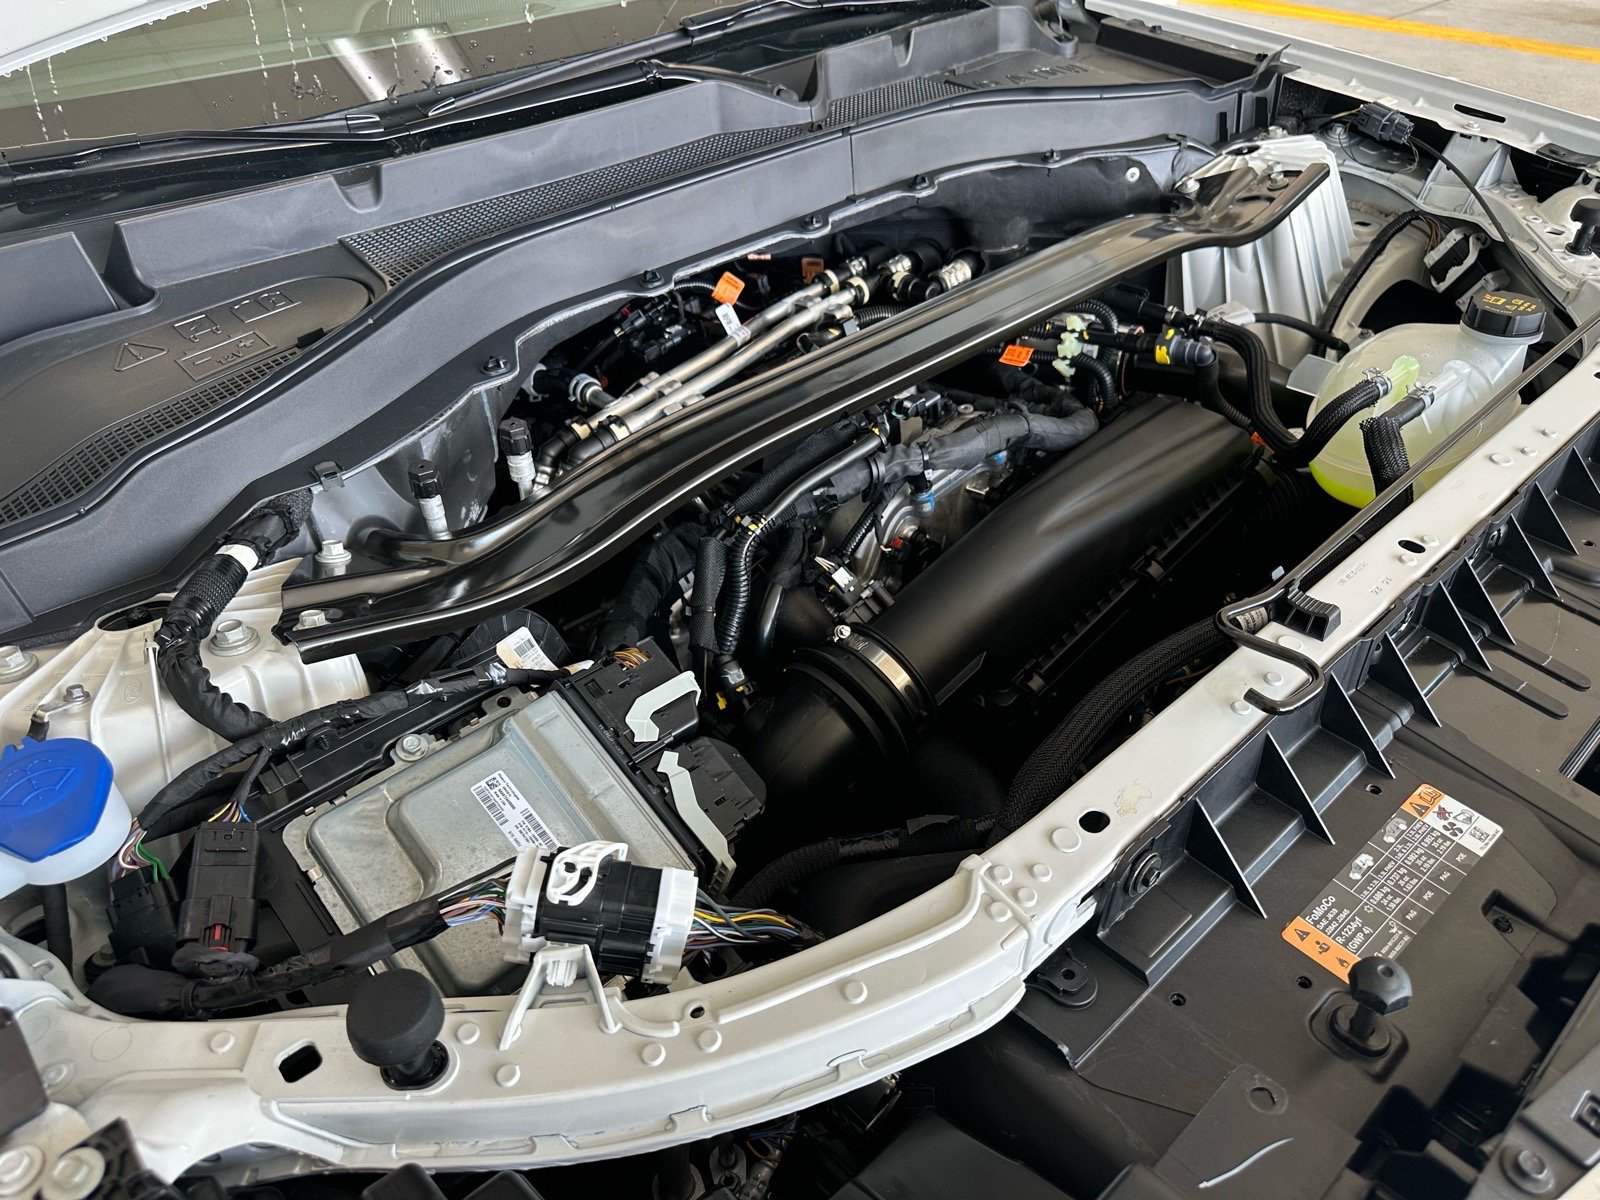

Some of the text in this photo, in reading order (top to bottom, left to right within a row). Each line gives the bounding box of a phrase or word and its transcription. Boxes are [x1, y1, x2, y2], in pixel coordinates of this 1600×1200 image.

[1413, 847, 1425, 855] kg
[1455, 852, 1467, 862] POE
[1386, 867, 1408, 886] 0.737 kg
[1439, 871, 1451, 881] PAG
[1379, 886, 1391, 894] kg
[1422, 890, 1434, 901] POE
[1380, 898, 1389, 906] 24
[1305, 895, 1336, 925] FoMoCo
[1405, 909, 1417, 921] PAG
[1316, 908, 1338, 930] SAE J639
[1325, 908, 1350, 936] J2842 J2845
[1335, 915, 1363, 944] R-1234yf
[1346, 926, 1374, 953] (GWP 4)
